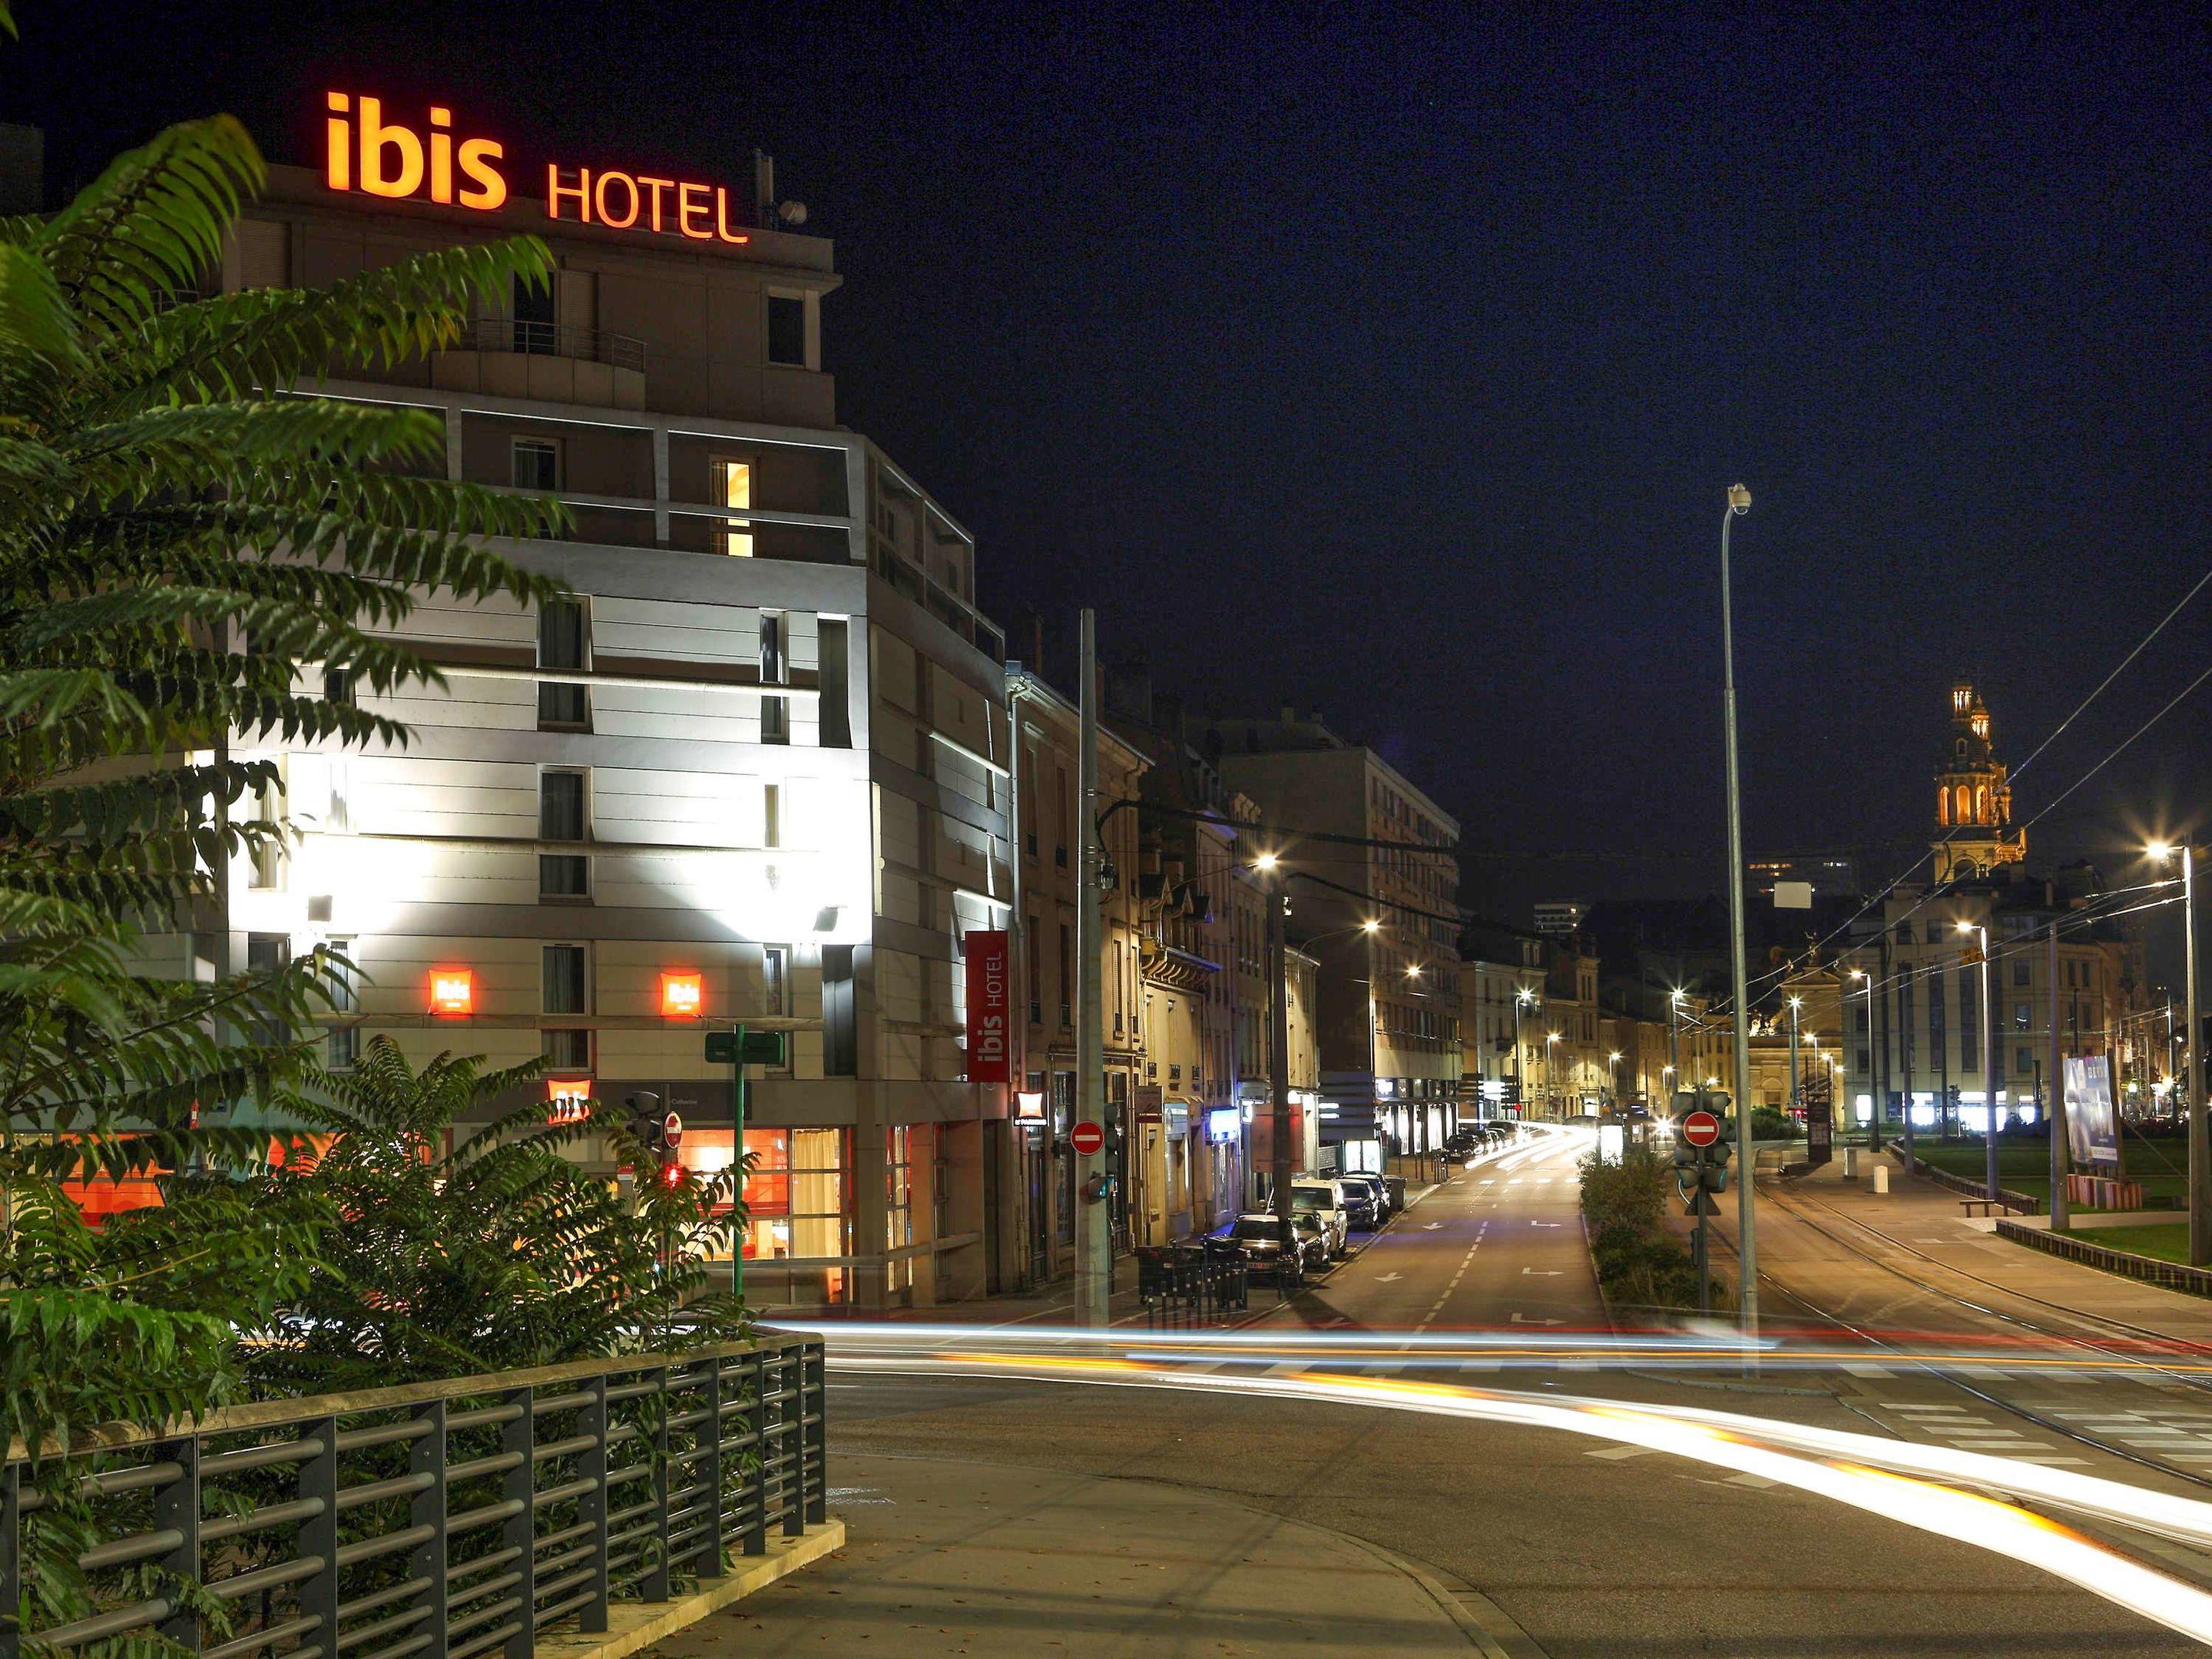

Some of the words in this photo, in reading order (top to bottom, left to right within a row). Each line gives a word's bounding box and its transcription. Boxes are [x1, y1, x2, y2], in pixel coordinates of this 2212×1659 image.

[327, 91, 508, 210] ibis
[548, 164, 748, 244] HOTEL
[986, 951, 1002, 1007] HOTEL
[977, 1015, 1004, 1062] ibis
